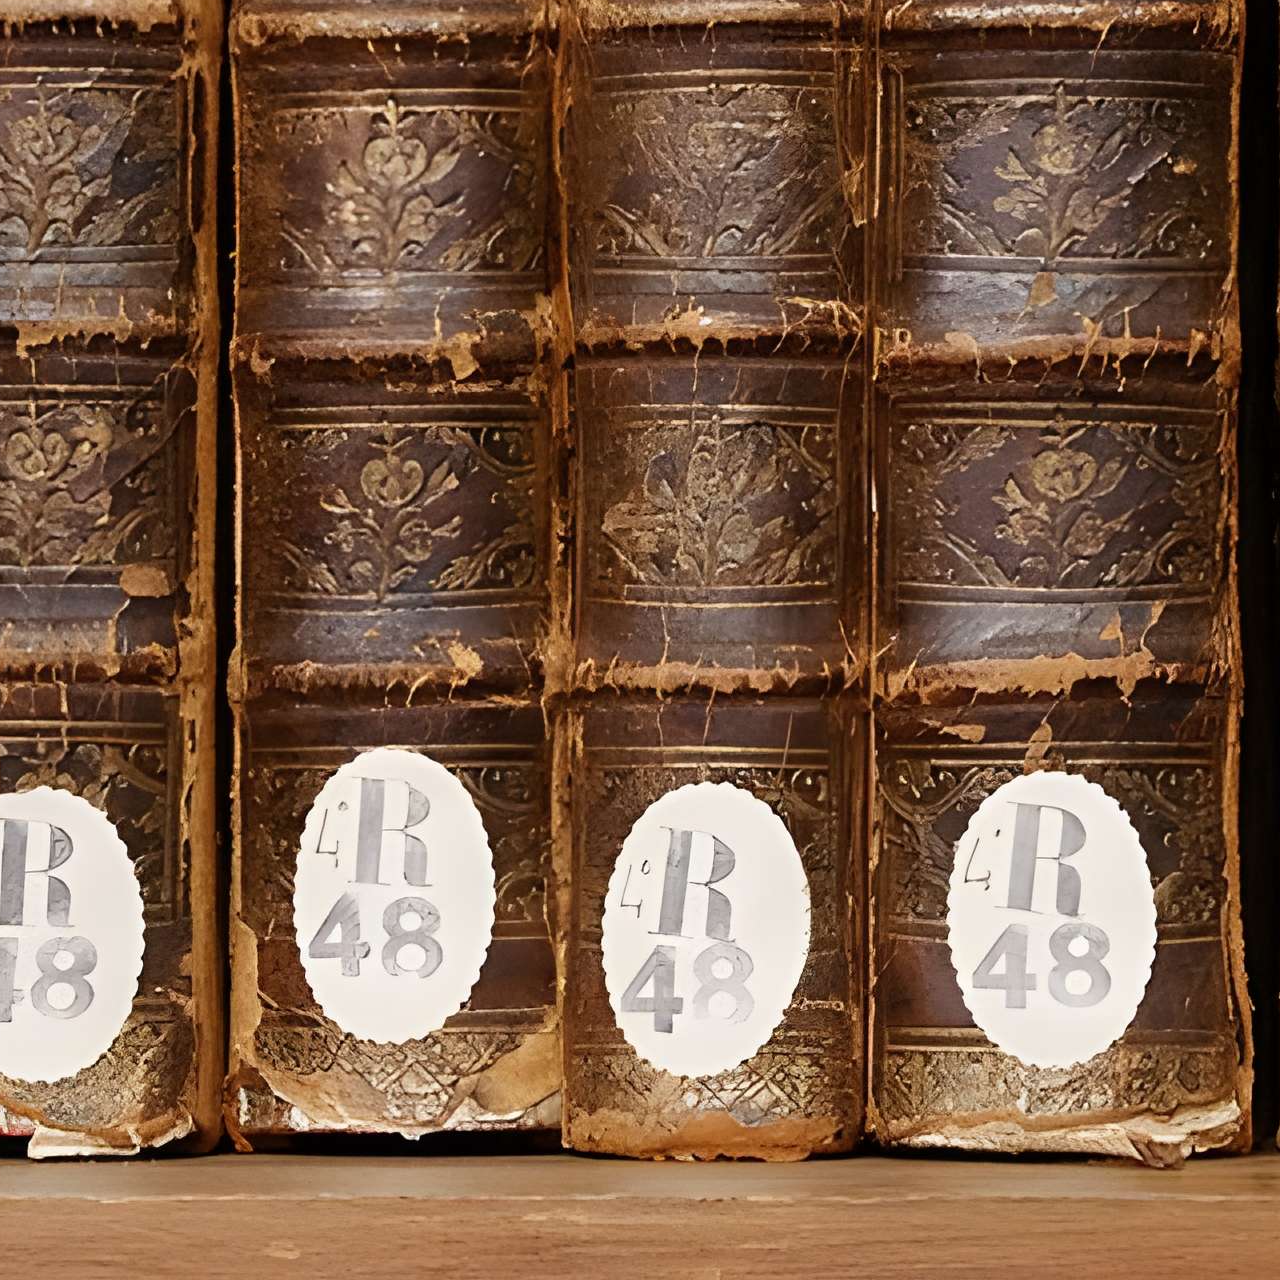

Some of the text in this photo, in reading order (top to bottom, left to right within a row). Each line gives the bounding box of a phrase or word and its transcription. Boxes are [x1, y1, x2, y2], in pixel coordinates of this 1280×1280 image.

[347, 776, 434, 888] R
[992, 801, 1087, 918] R
[647, 824, 737, 943] R
[308, 892, 444, 979] 48
[972, 922, 1112, 1010] 48
[620, 942, 755, 1034] 48
